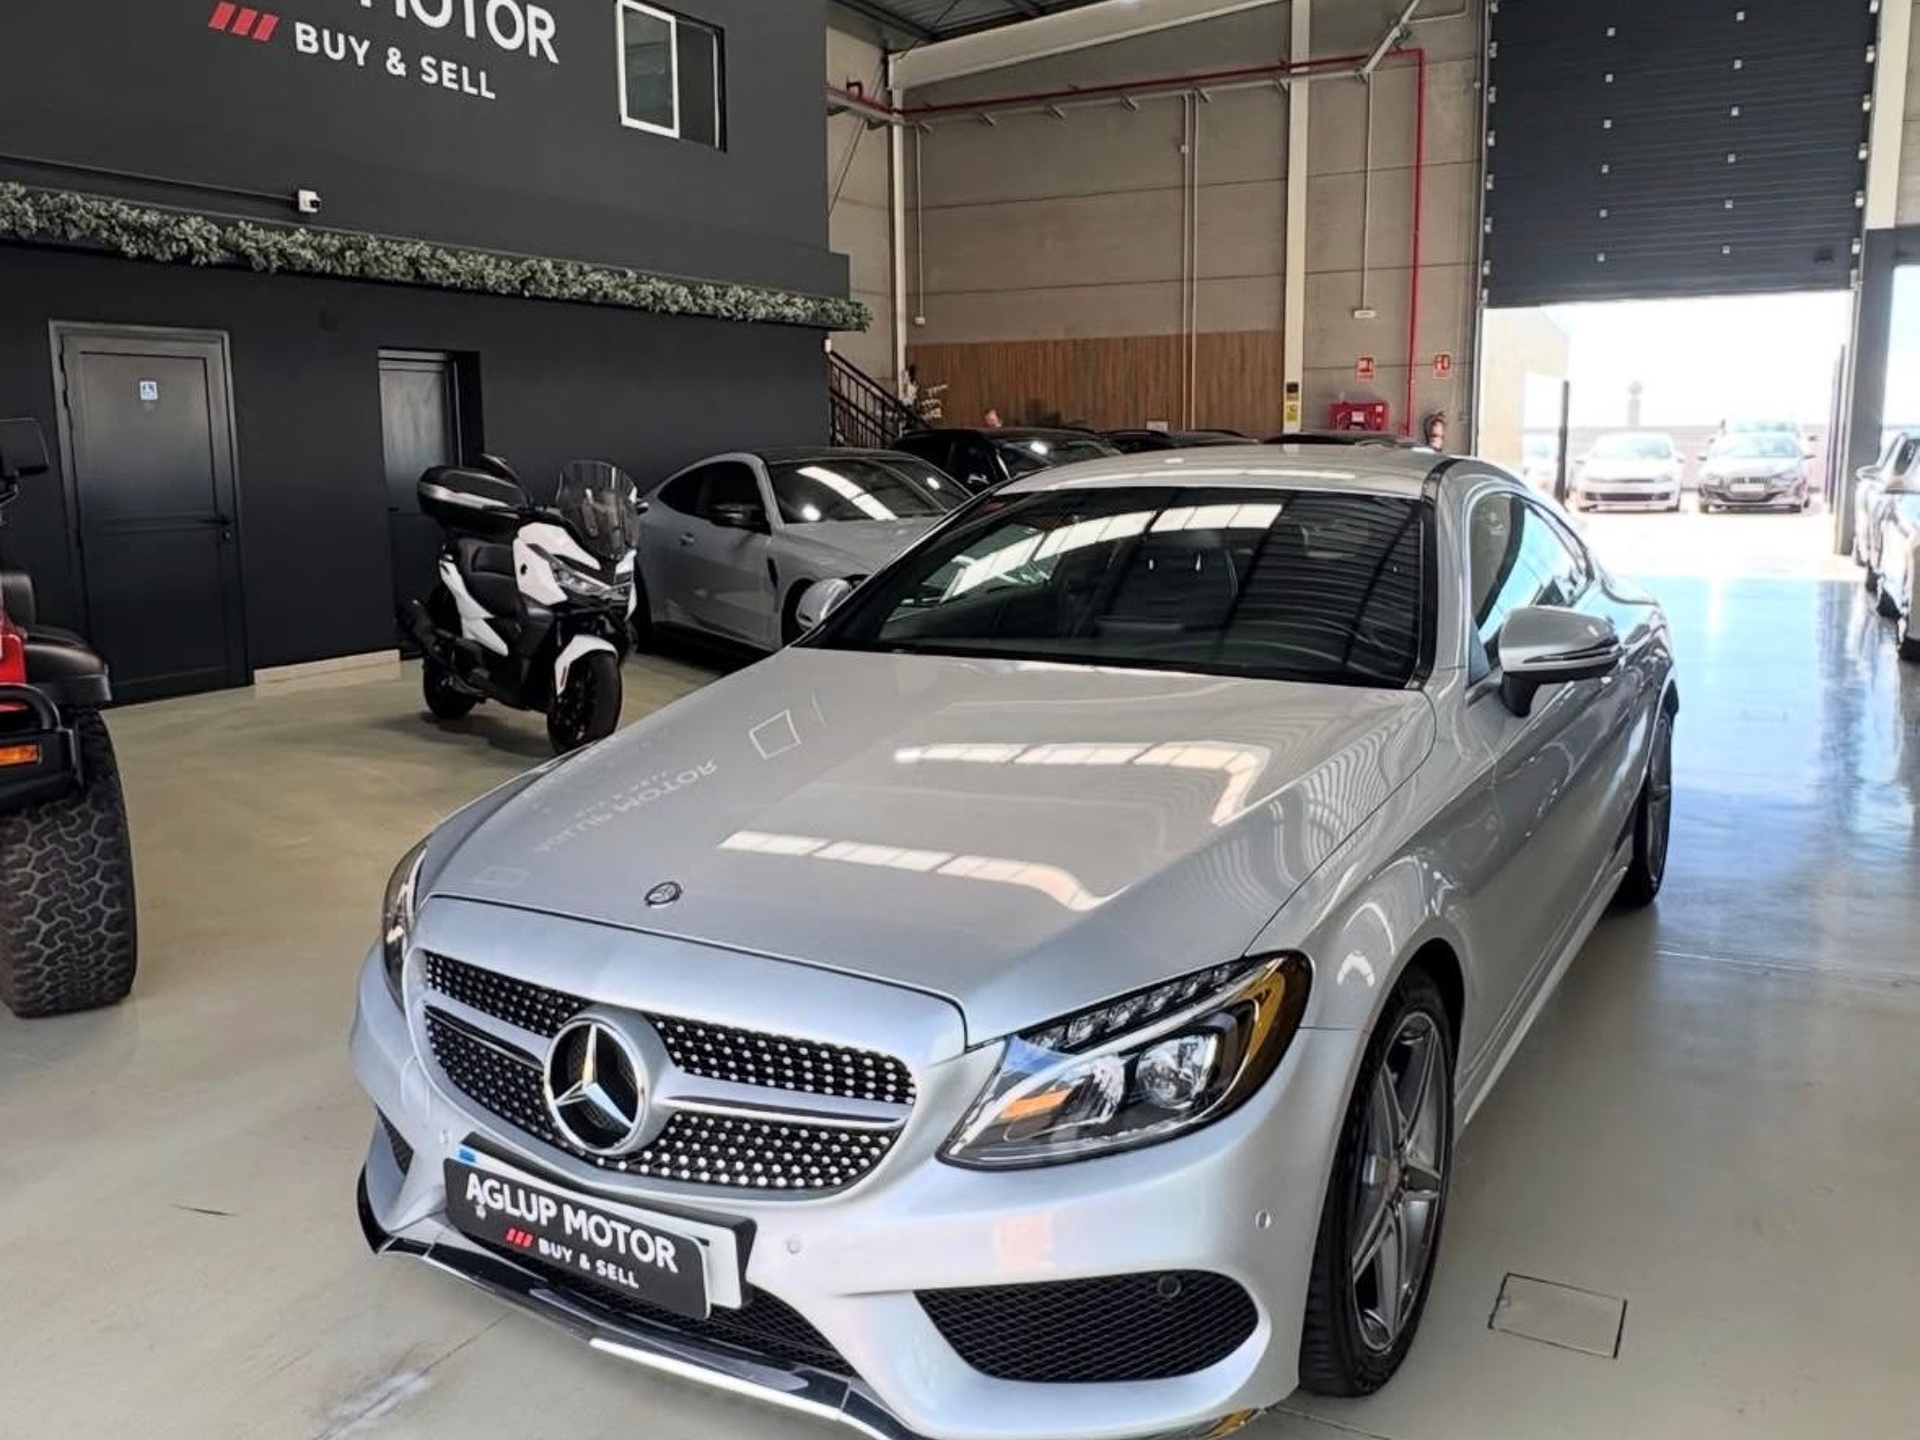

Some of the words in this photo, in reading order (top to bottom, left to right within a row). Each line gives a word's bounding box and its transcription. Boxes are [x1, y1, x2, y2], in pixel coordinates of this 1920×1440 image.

[295, 21, 370, 66] BUY
[385, 46, 407, 77] &
[420, 56, 496, 99] SELL
[359, 0, 560, 64] OTOR
[466, 1173, 557, 1226] AGLUP
[563, 1204, 678, 1273] MOTOR
[538, 1238, 574, 1264] BUY
[579, 1253, 591, 1271] &
[596, 1260, 639, 1288] SELL
